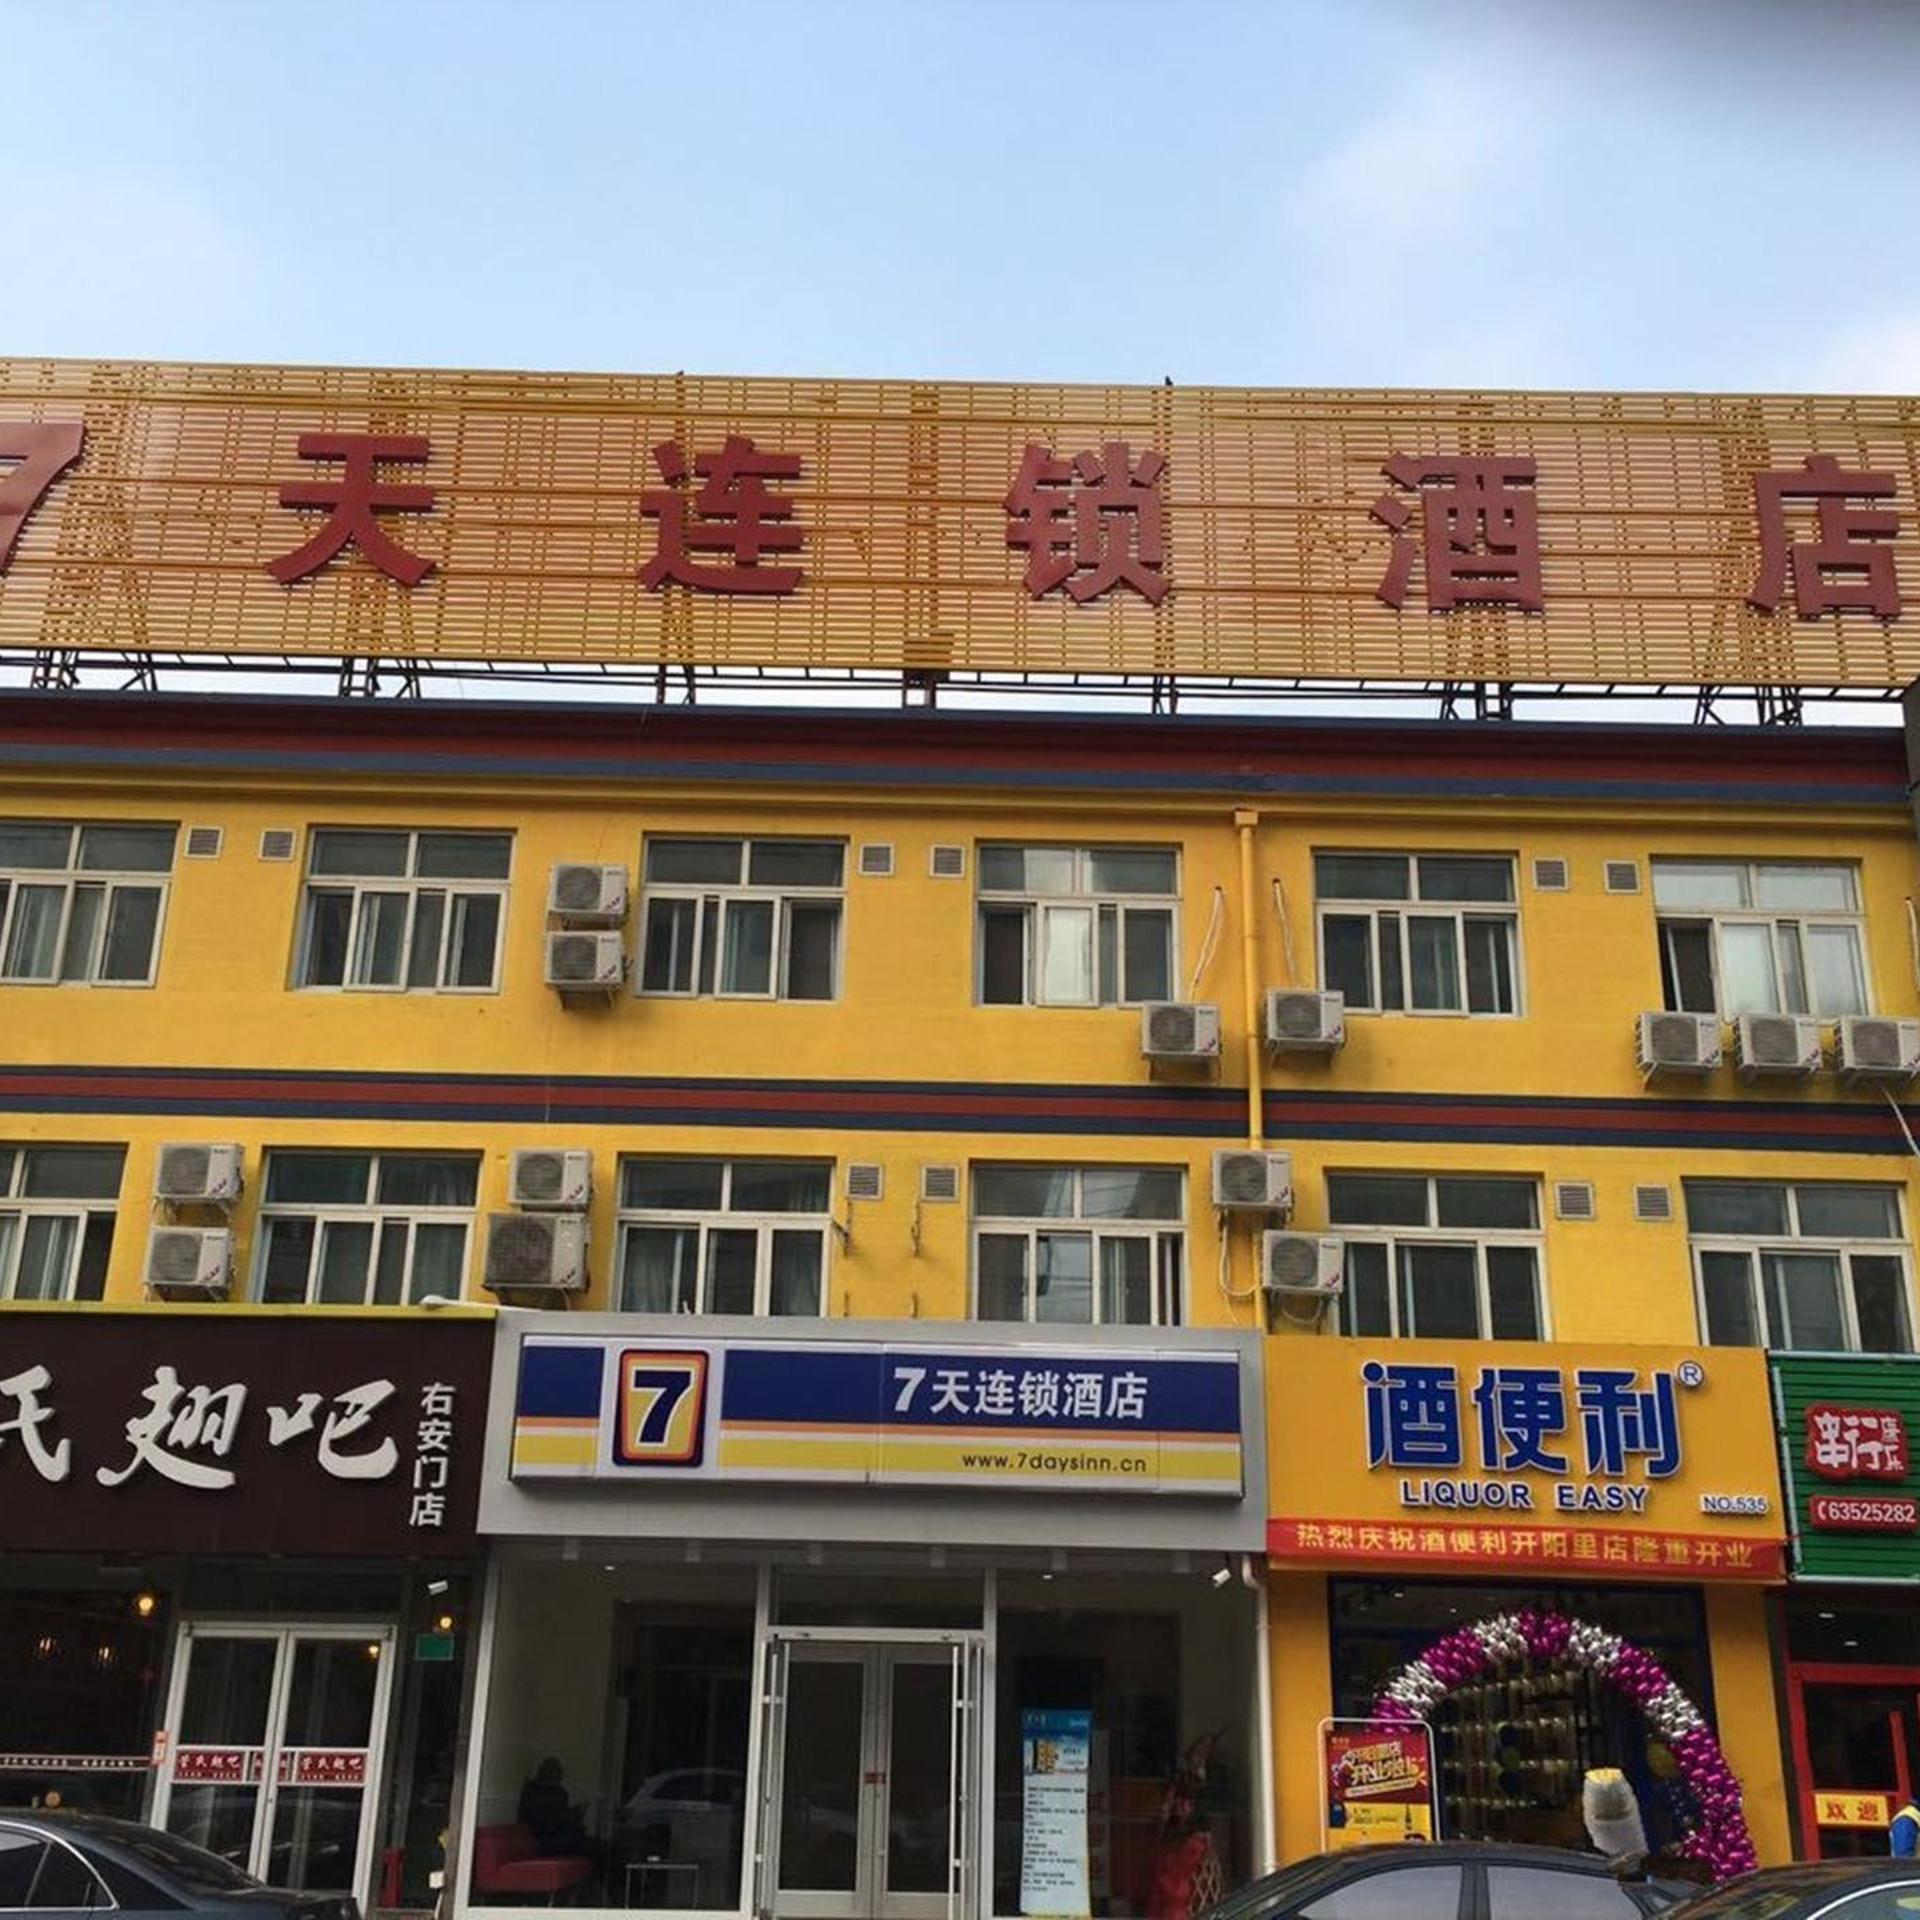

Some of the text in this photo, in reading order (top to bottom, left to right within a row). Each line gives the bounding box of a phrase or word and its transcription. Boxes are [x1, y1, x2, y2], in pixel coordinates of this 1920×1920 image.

[631, 1366, 694, 1447] 7
[894, 1366, 1149, 1419] 7天连锁酒店
[1362, 1360, 1683, 1478] 酒便利
[409, 1382, 457, 1528] 右安门店
[962, 1453, 1147, 1472] www.7daysinn.cn
[1401, 1480, 1650, 1513] LIQUOR EASY
[1701, 1495, 1769, 1515] NO.535
[1828, 1501, 1916, 1523] 63525282
[1297, 1523, 1753, 1568] 热烈庆祝酒便利开阳里店隆重开业
